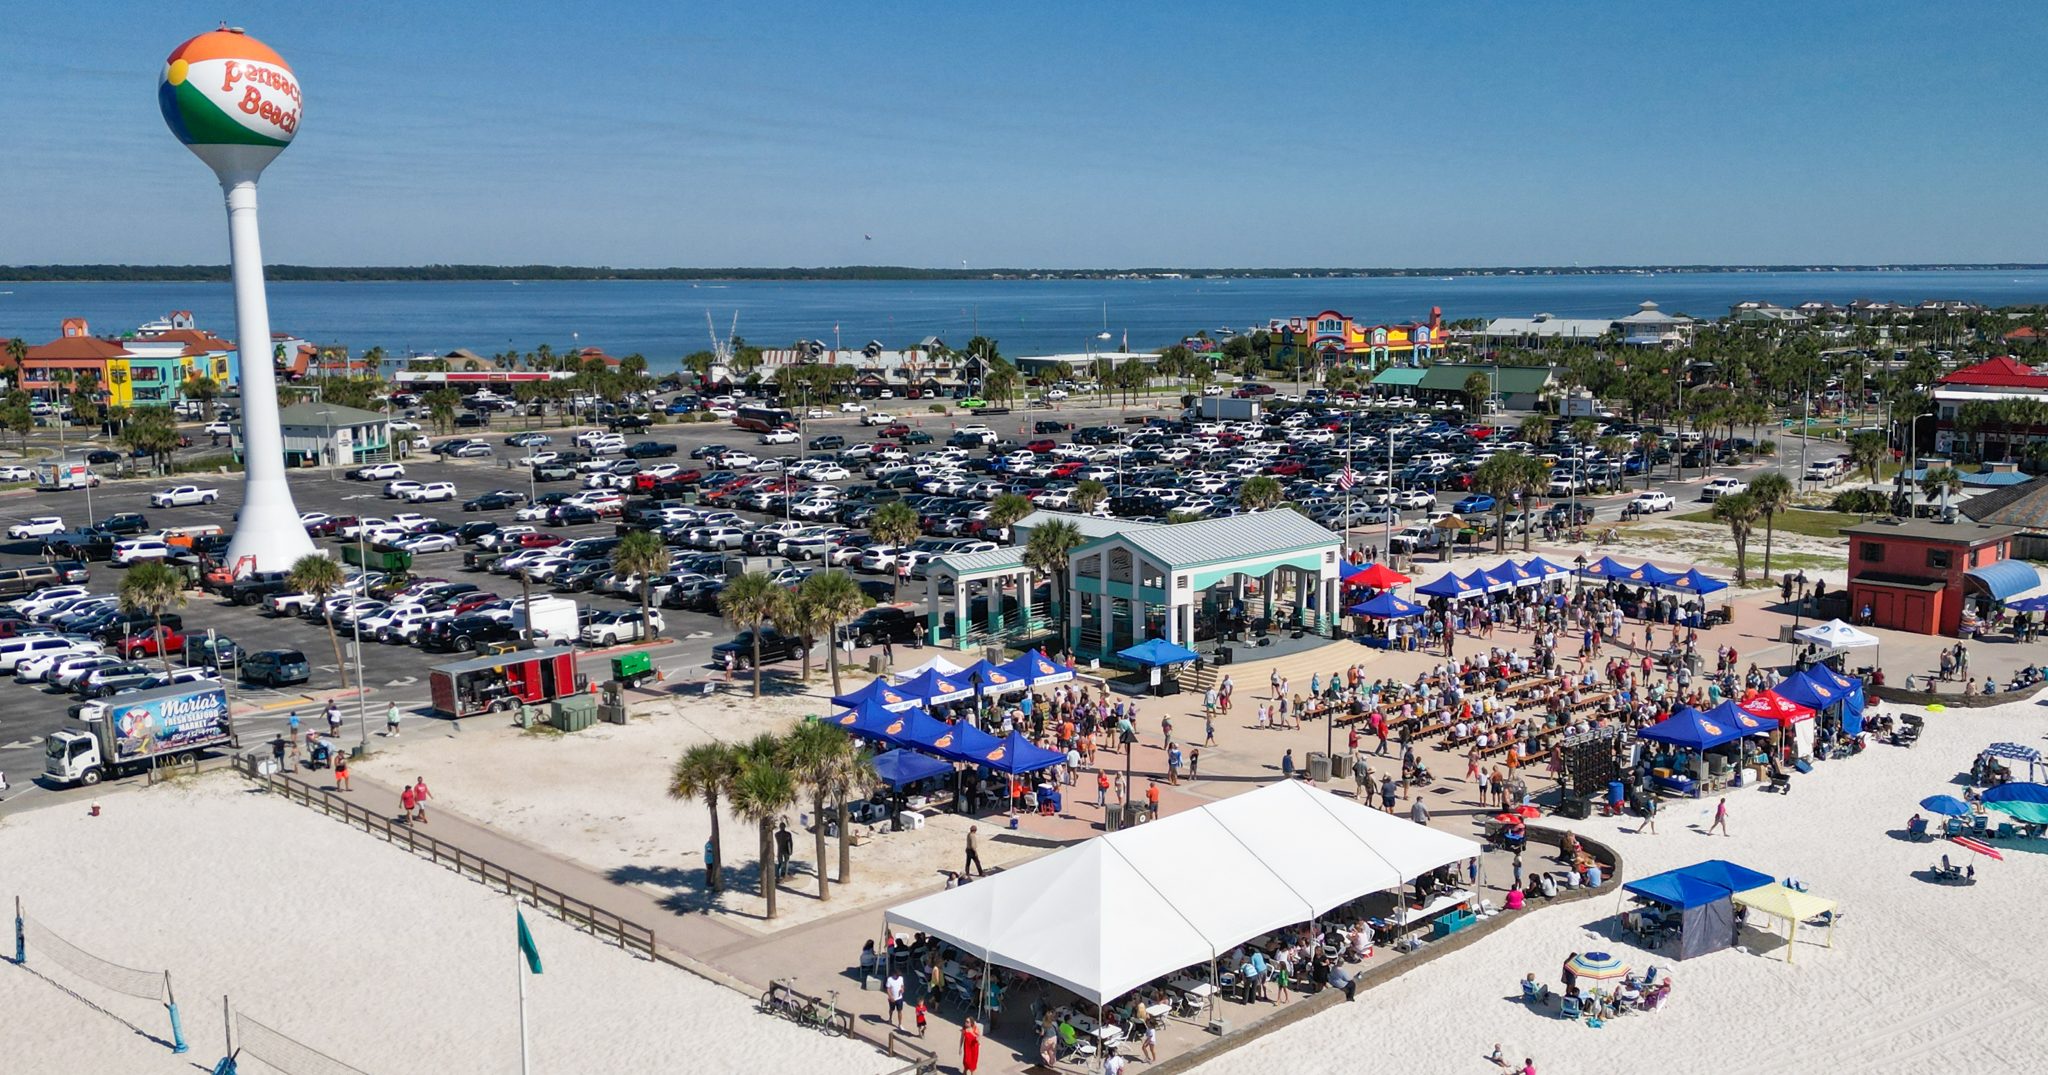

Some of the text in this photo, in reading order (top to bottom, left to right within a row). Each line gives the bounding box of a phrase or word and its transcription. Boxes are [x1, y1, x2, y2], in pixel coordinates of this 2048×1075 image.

[238, 85, 297, 134] Beach
[160, 693, 219, 718] Maria's
[179, 720, 207, 732] MARKET
